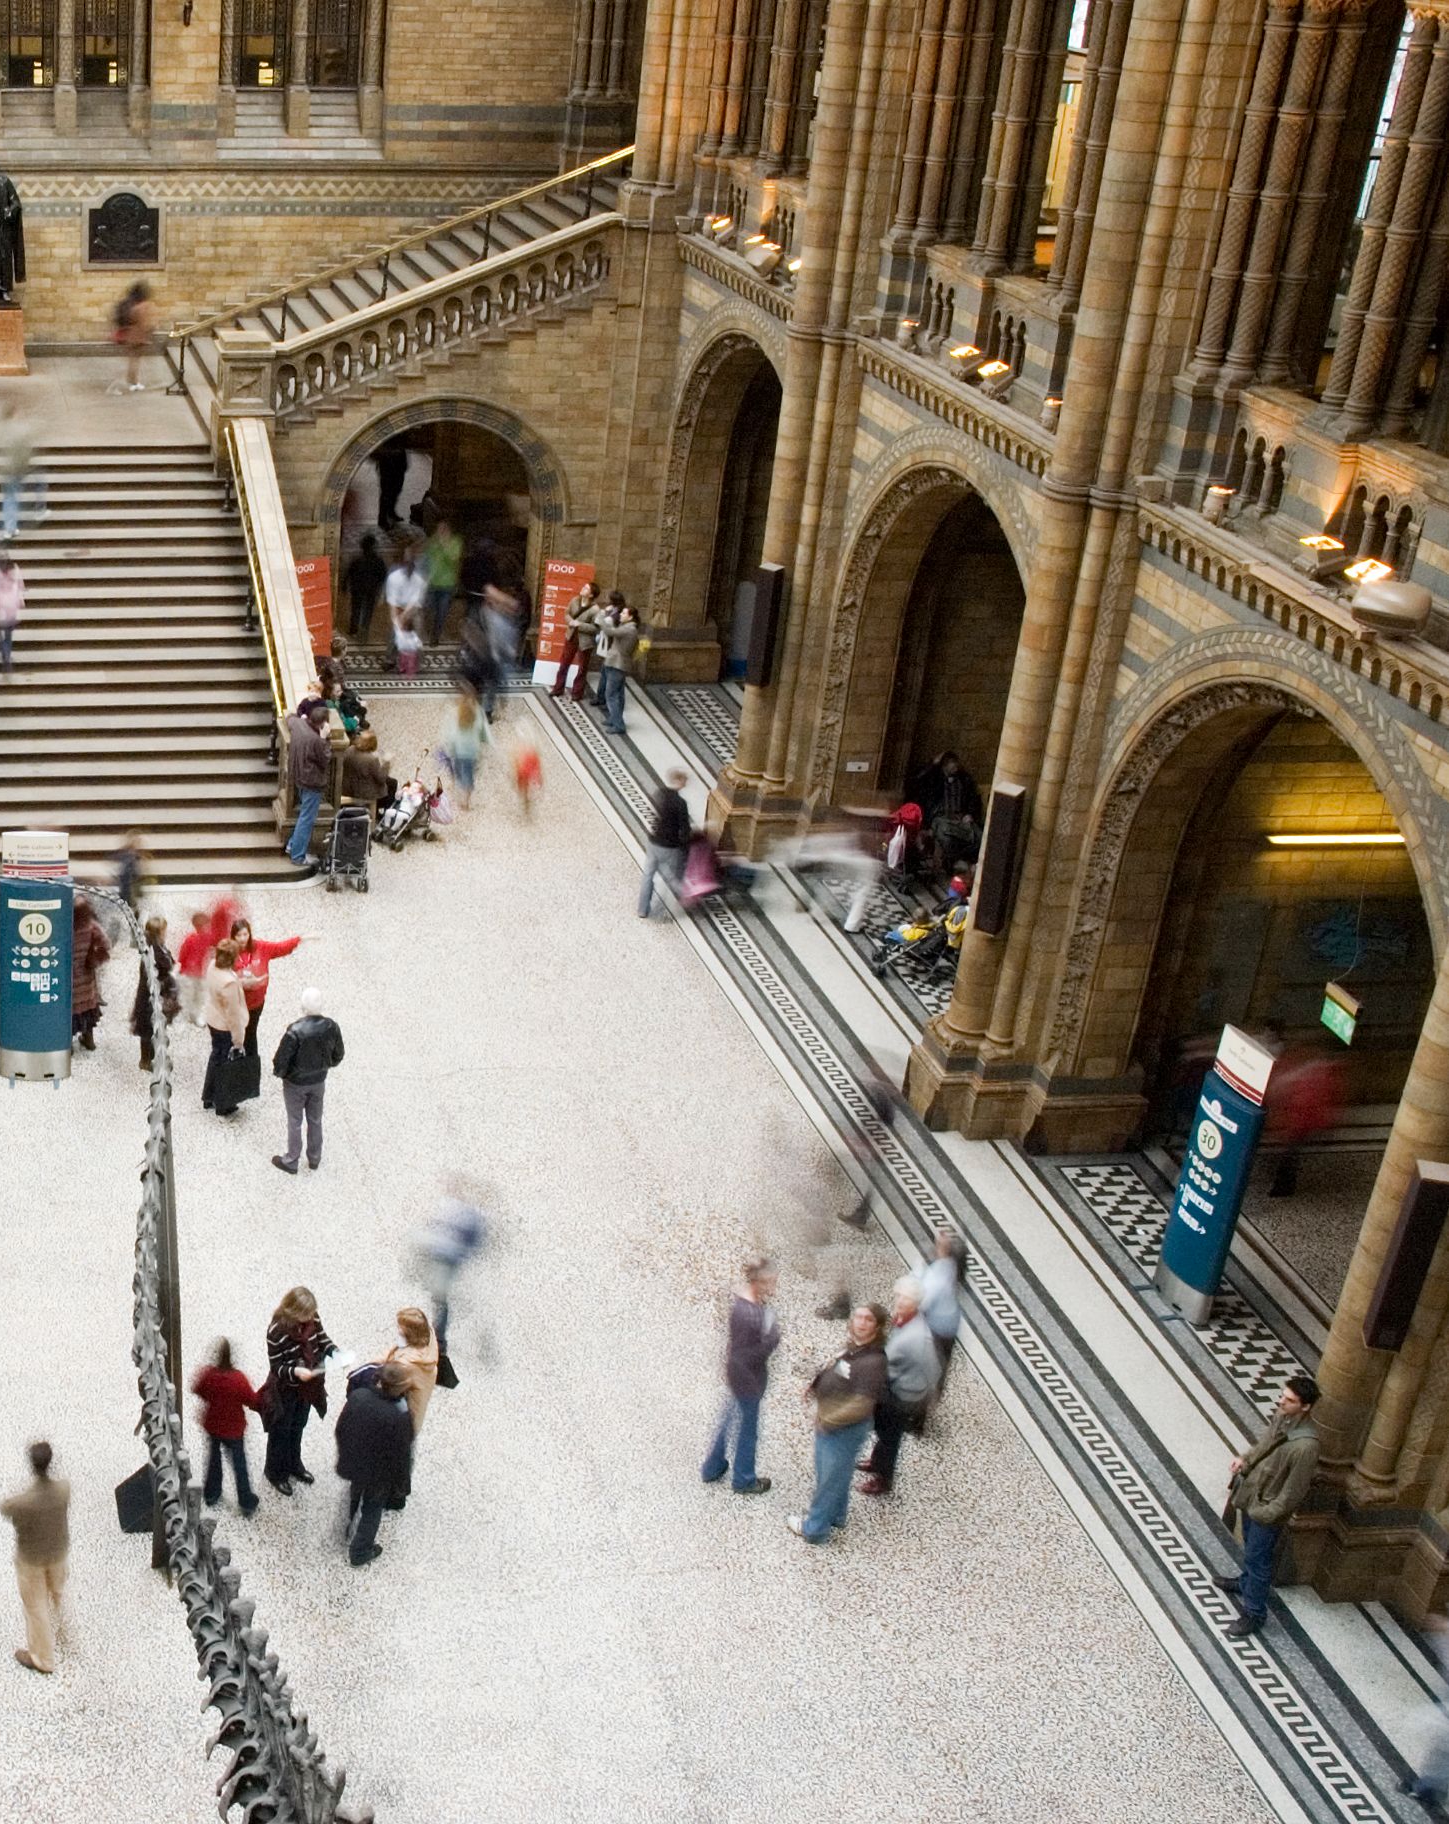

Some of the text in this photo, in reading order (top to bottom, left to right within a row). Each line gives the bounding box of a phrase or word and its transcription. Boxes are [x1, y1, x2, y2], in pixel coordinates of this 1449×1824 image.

[548, 563, 575, 574] FOOD
[25, 922, 46, 936] 10
[1200, 1128, 1217, 1151] 30
